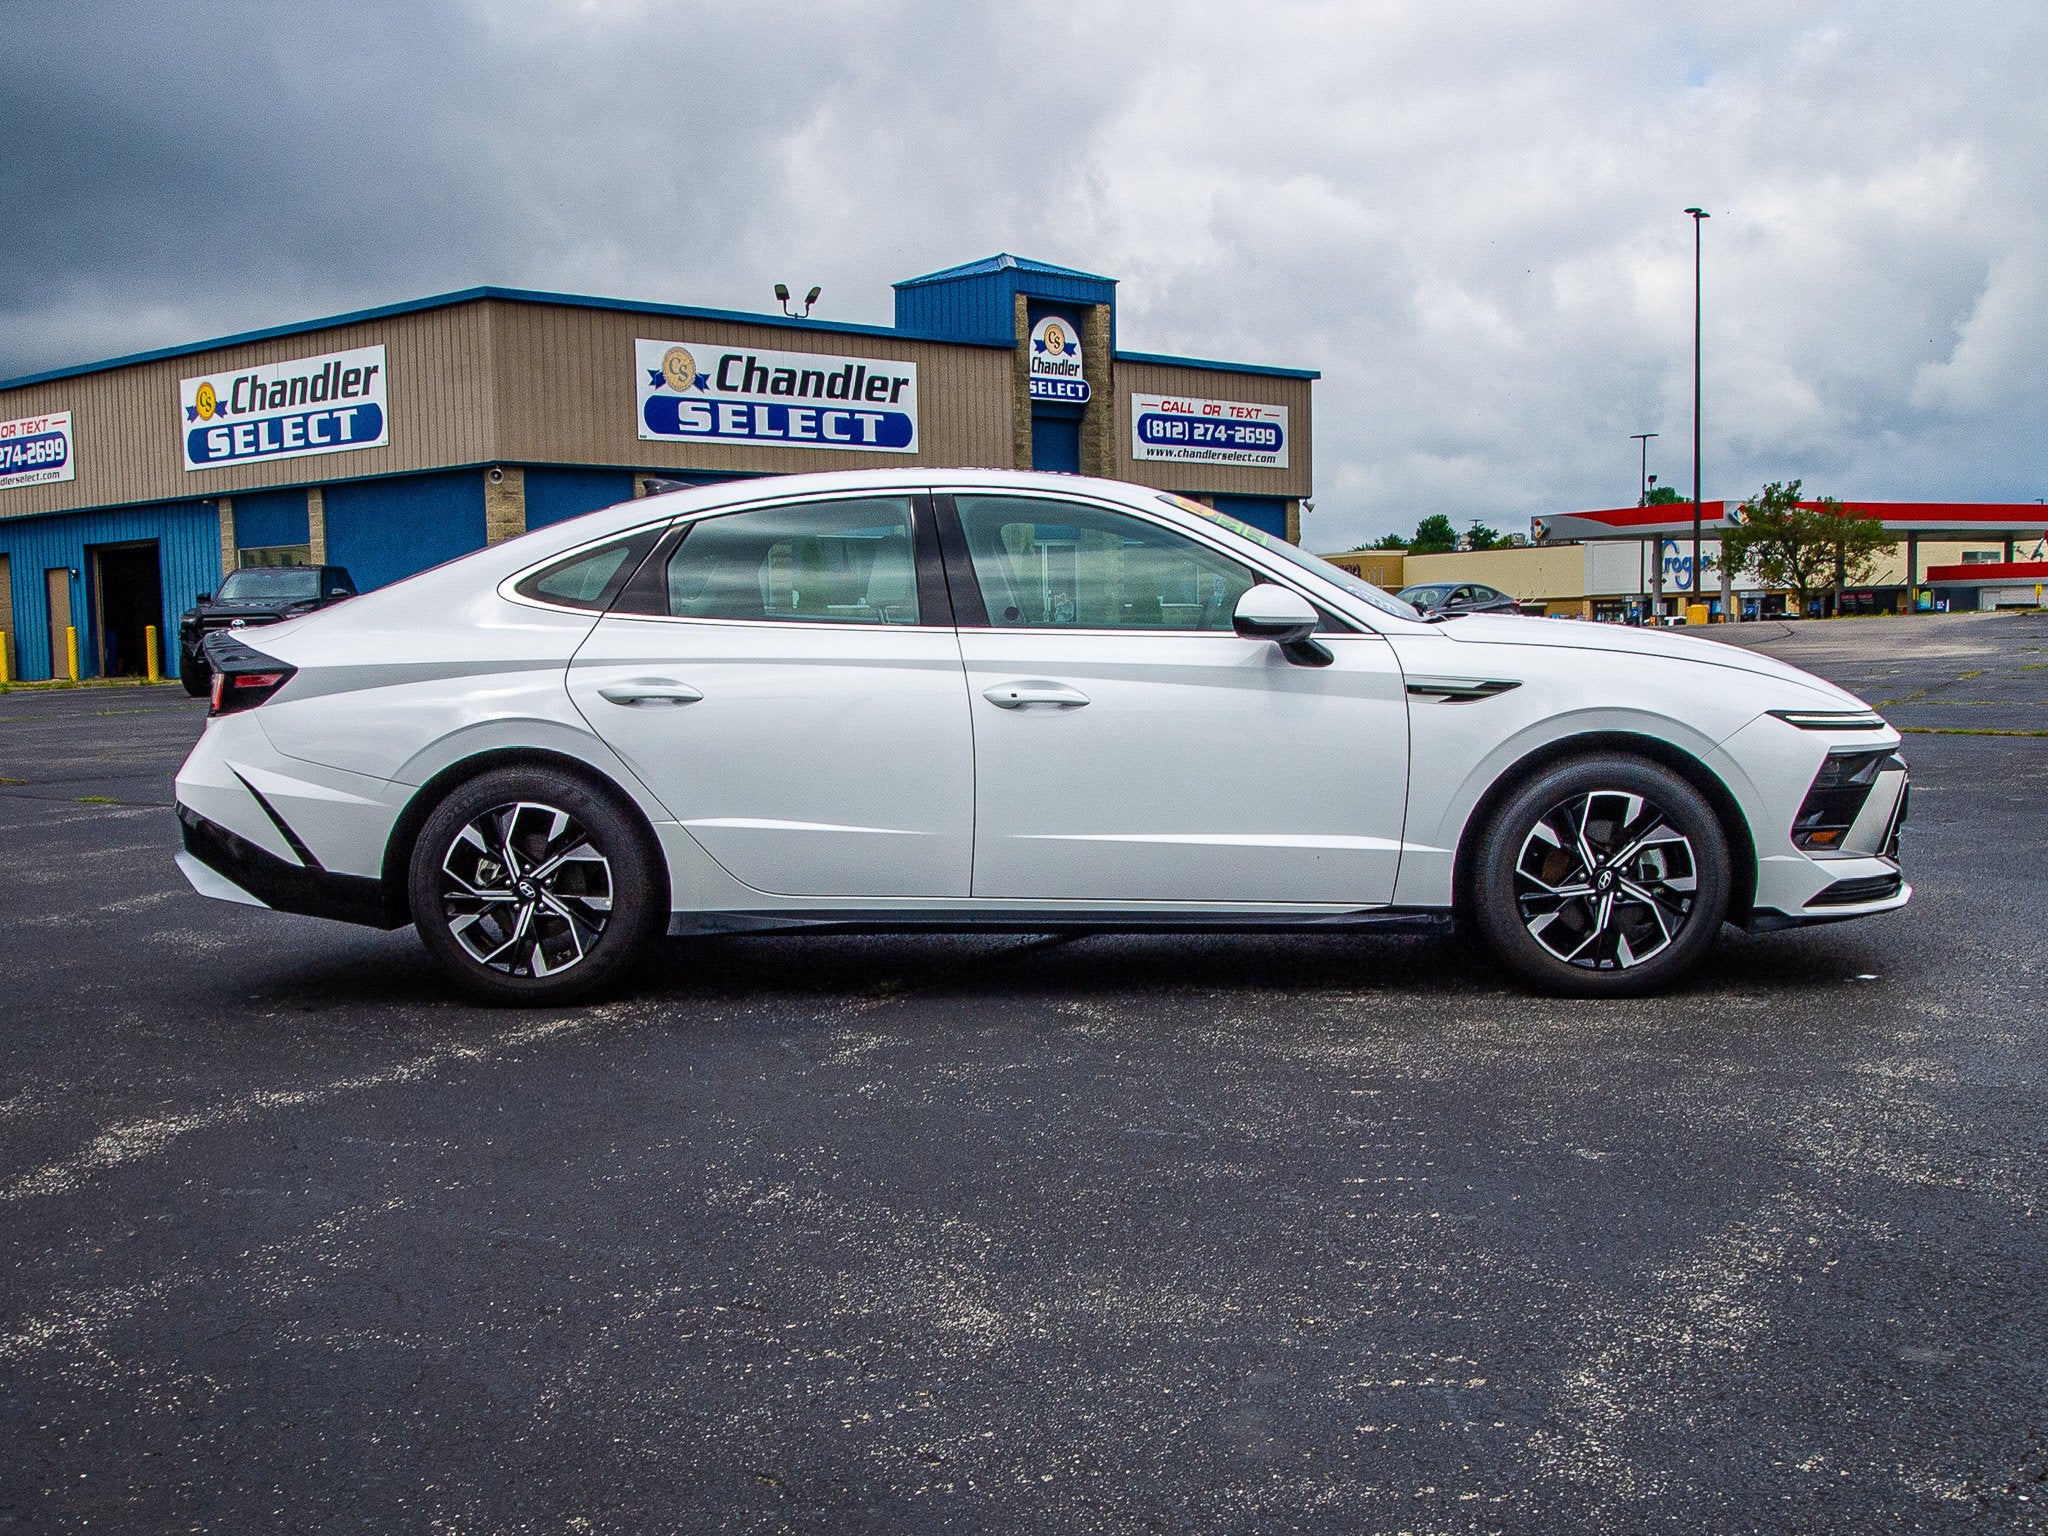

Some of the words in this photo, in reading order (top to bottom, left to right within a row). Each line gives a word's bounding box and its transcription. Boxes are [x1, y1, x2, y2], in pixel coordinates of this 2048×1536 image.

[1048, 331, 1061, 349] CS
[669, 357, 689, 383] CS
[1031, 356, 1080, 377] Chandler
[231, 361, 379, 414] Chandler
[716, 353, 909, 404] Chandler
[1030, 380, 1085, 397] SELECT
[200, 391, 212, 412] CS
[1161, 400, 1195, 414] CALL
[1202, 403, 1222, 416] OR
[1229, 406, 1262, 419] TEXT
[1, 424, 16, 438] OR
[20, 418, 48, 435] TEXT
[678, 401, 884, 442] SELECT
[1146, 419, 1189, 440] (812)
[1194, 423, 1276, 445] 274-2699
[208, 409, 357, 458] SELECT
[1146, 448, 1276, 463] www.chandlerselect.com
